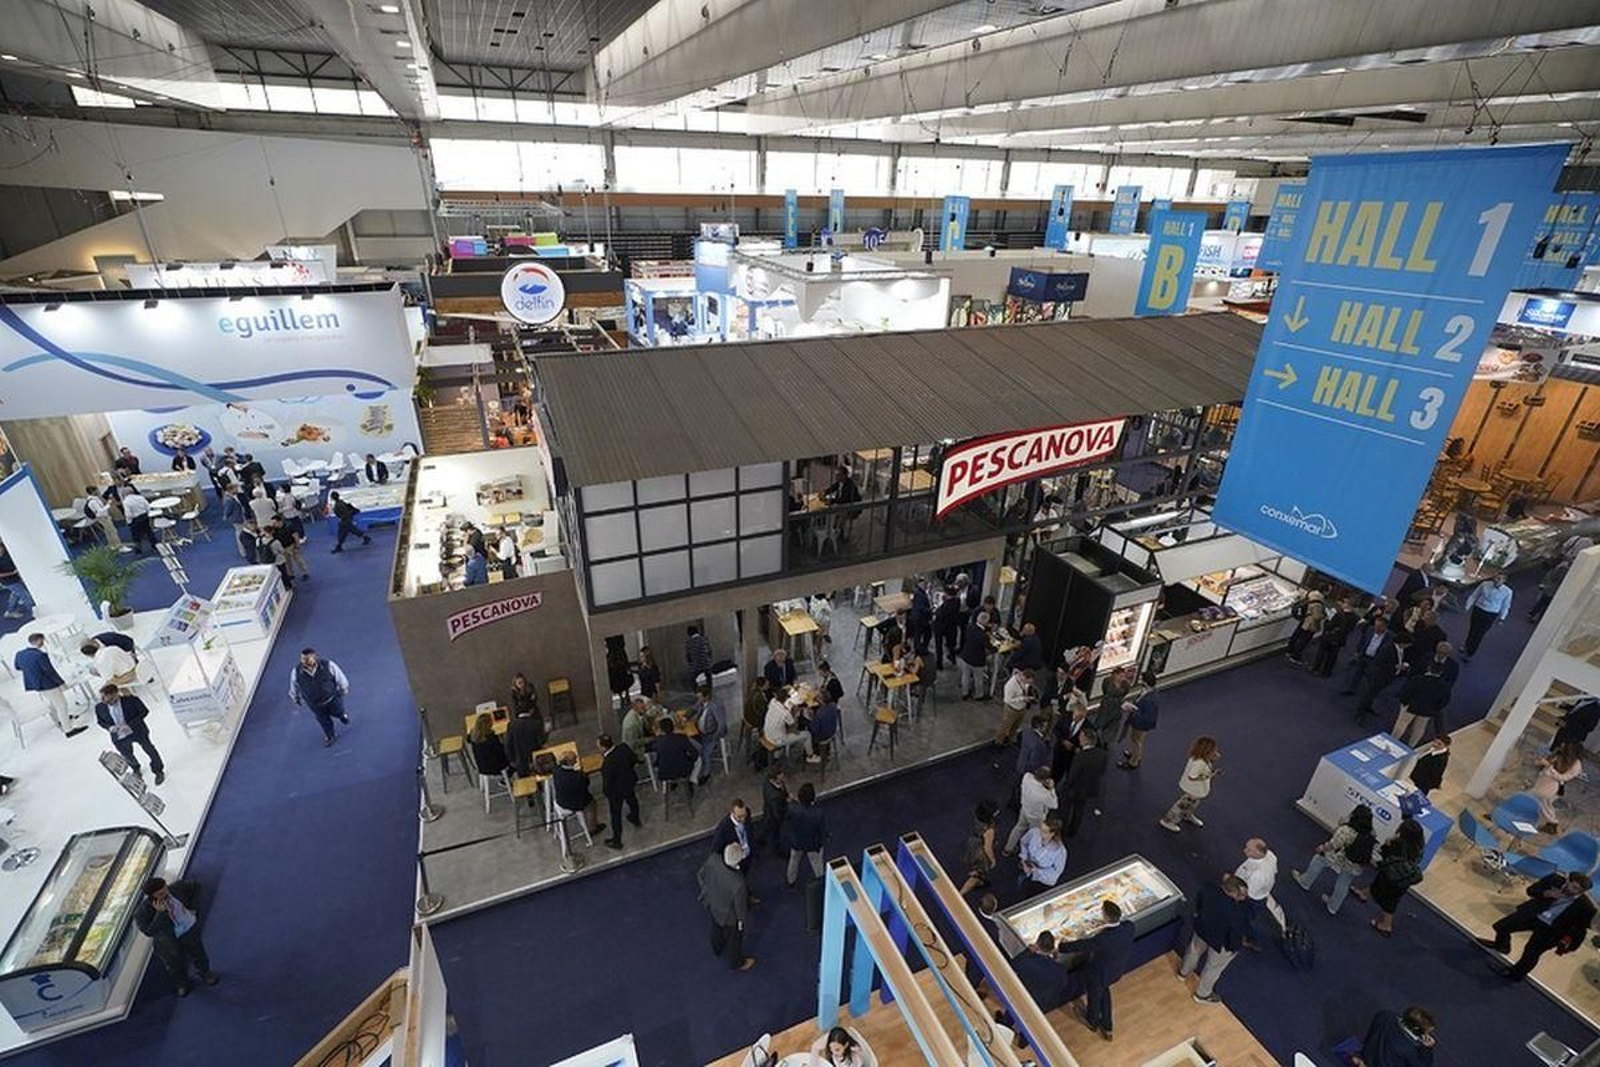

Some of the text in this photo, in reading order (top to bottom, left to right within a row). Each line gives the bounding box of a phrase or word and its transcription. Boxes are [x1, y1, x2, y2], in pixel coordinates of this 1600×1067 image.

[1163, 221, 1196, 237] HALL 1
[1304, 201, 1515, 277] HALL 1
[1146, 244, 1186, 311] B
[218, 308, 341, 339] eguillem
[1330, 301, 1476, 363] HALL 2
[1312, 365, 1446, 430] HALL 3
[945, 424, 1116, 499] PESCANOVA
[1260, 504, 1323, 535] conxemar
[450, 594, 540, 634] PESCANOVA
